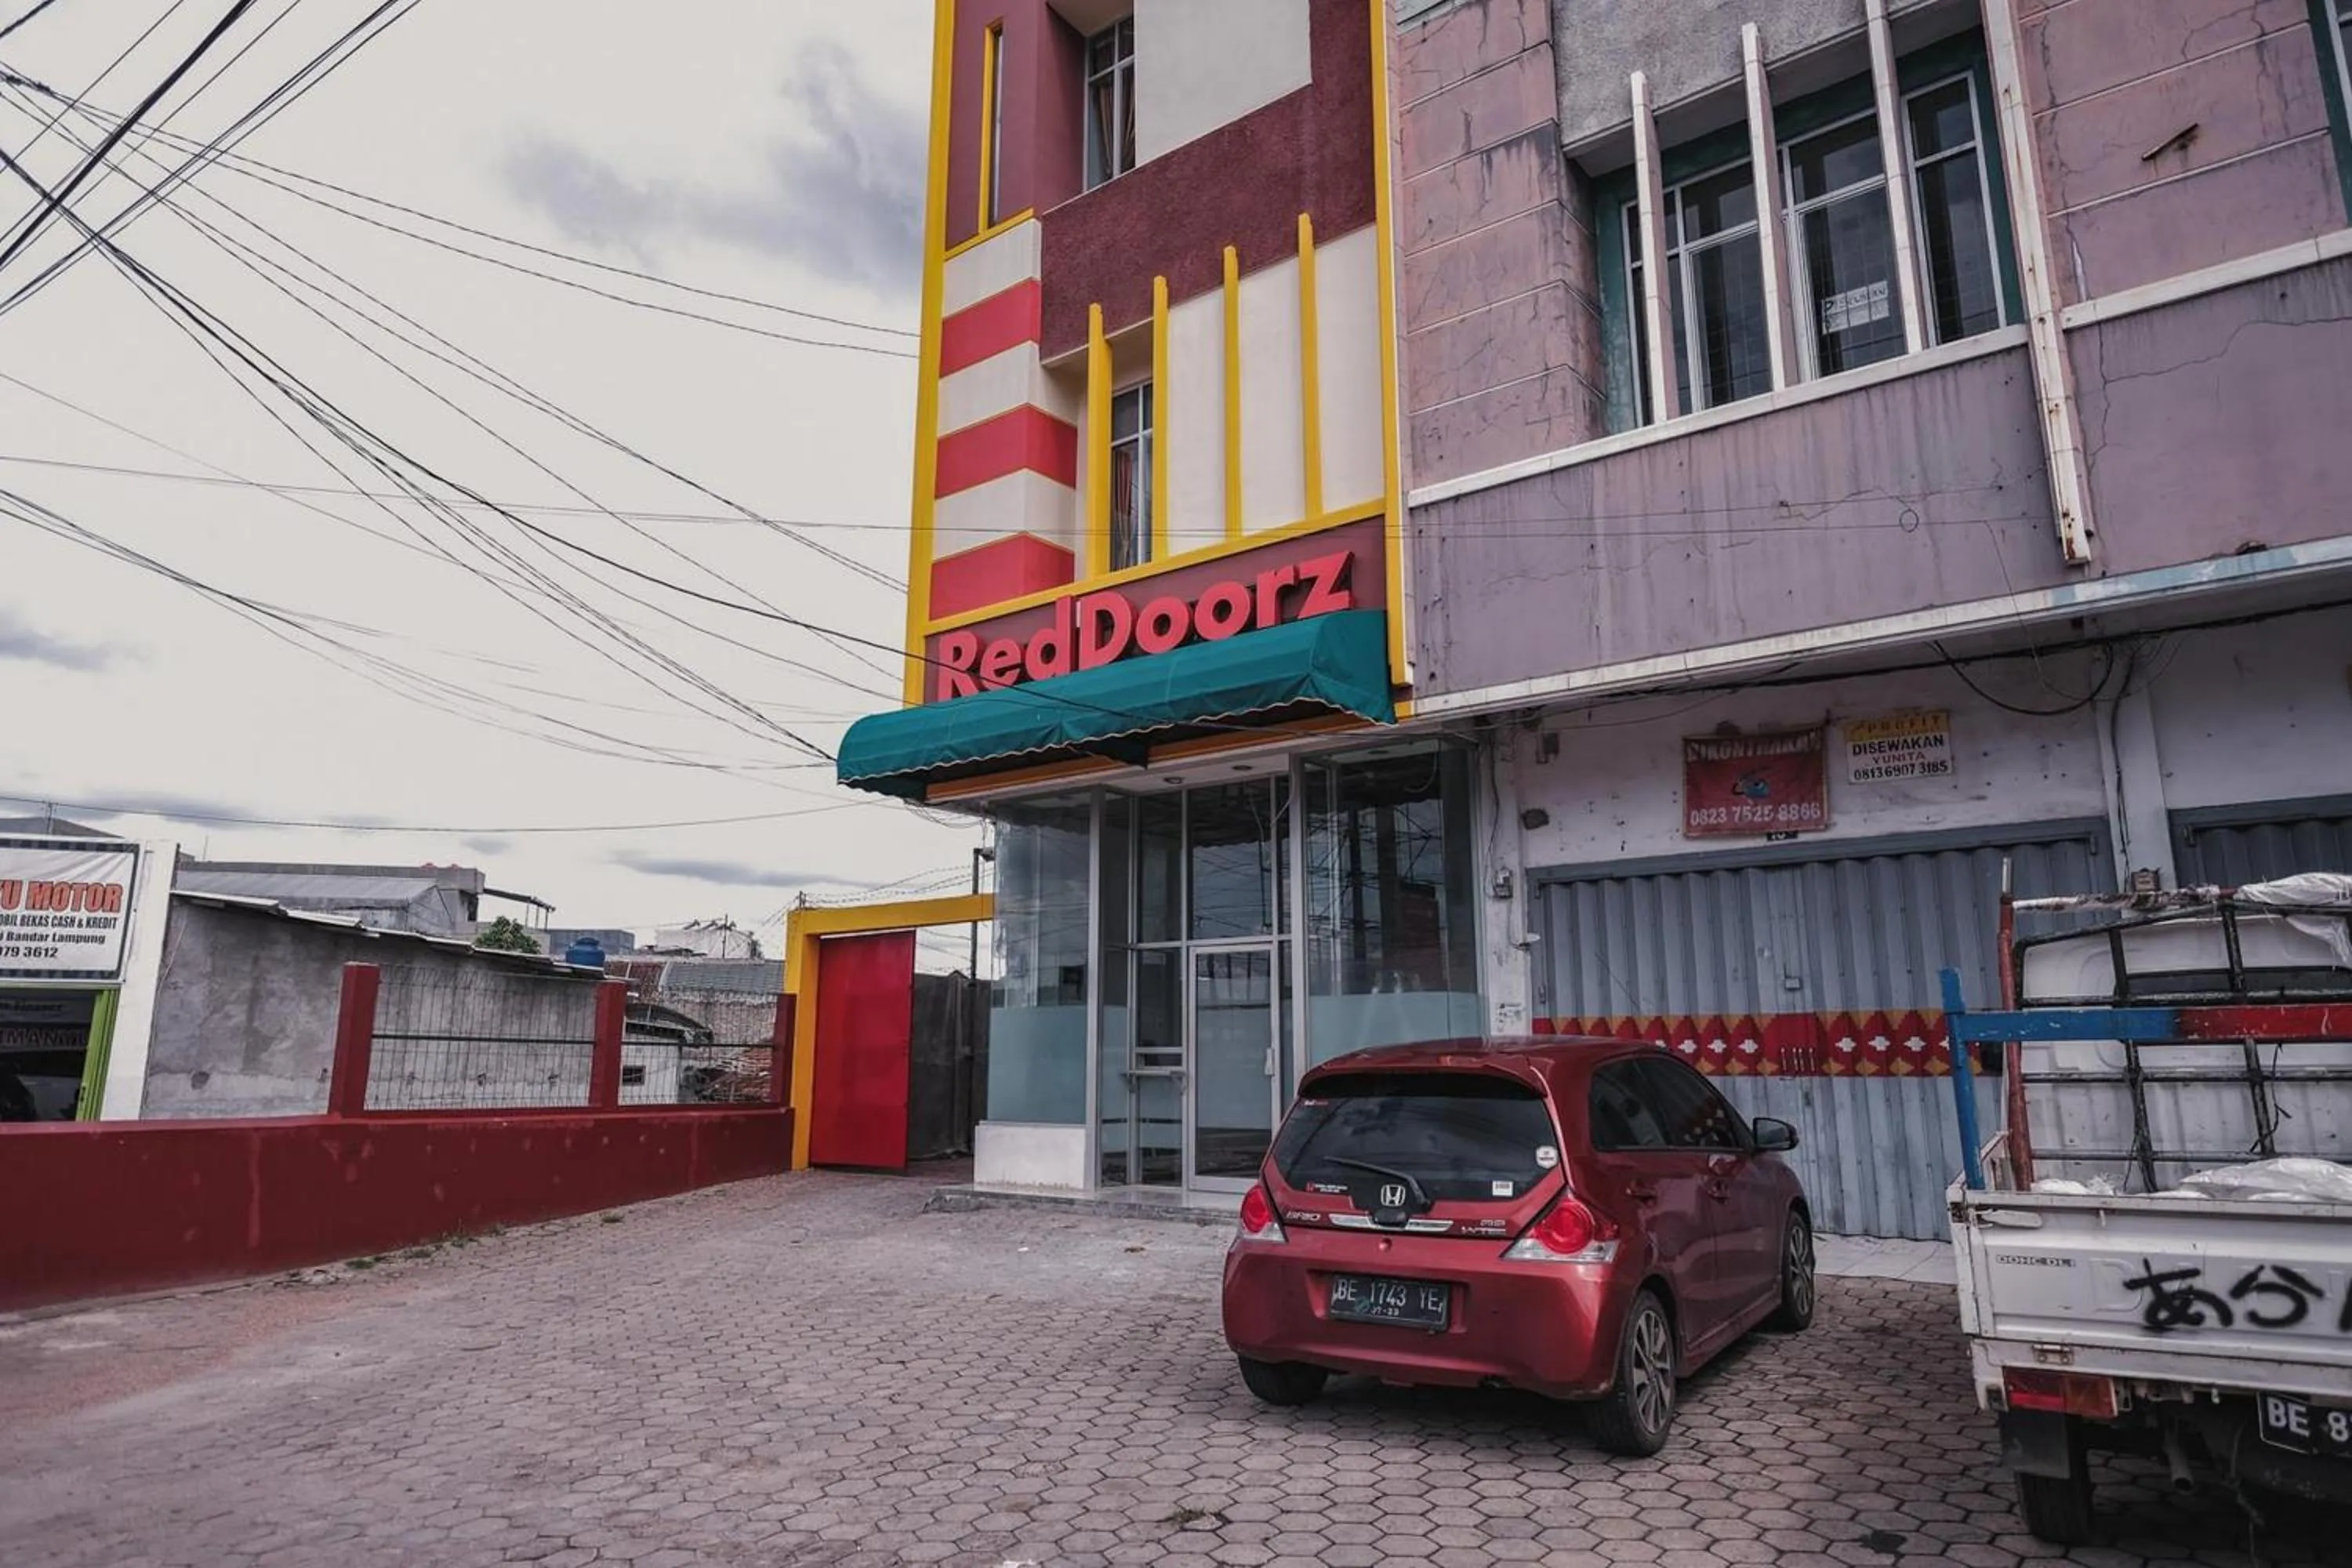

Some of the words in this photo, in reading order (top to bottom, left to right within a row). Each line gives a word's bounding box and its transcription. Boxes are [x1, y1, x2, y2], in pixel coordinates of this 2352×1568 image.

[937, 551, 1355, 702] RedDoorz
[1853, 734, 1944, 756] DISEWAKAN
[1872, 751, 1926, 764] YUNITA
[0, 879, 23, 910] U
[25, 880, 123, 913] MOTOR
[20, 914, 49, 927] BEKAS
[51, 916, 76, 929] CASH
[77, 919, 84, 929] &
[85, 917, 118, 930] KREDIT
[6, 931, 50, 942] Bandar
[52, 932, 106, 945] Lampung
[23, 946, 59, 958] 3612
[1338, 1279, 1359, 1301] BE
[1370, 1281, 1406, 1307] 1743
[2266, 1396, 2310, 1438] BE
[2327, 1411, 2352, 1442] 8
